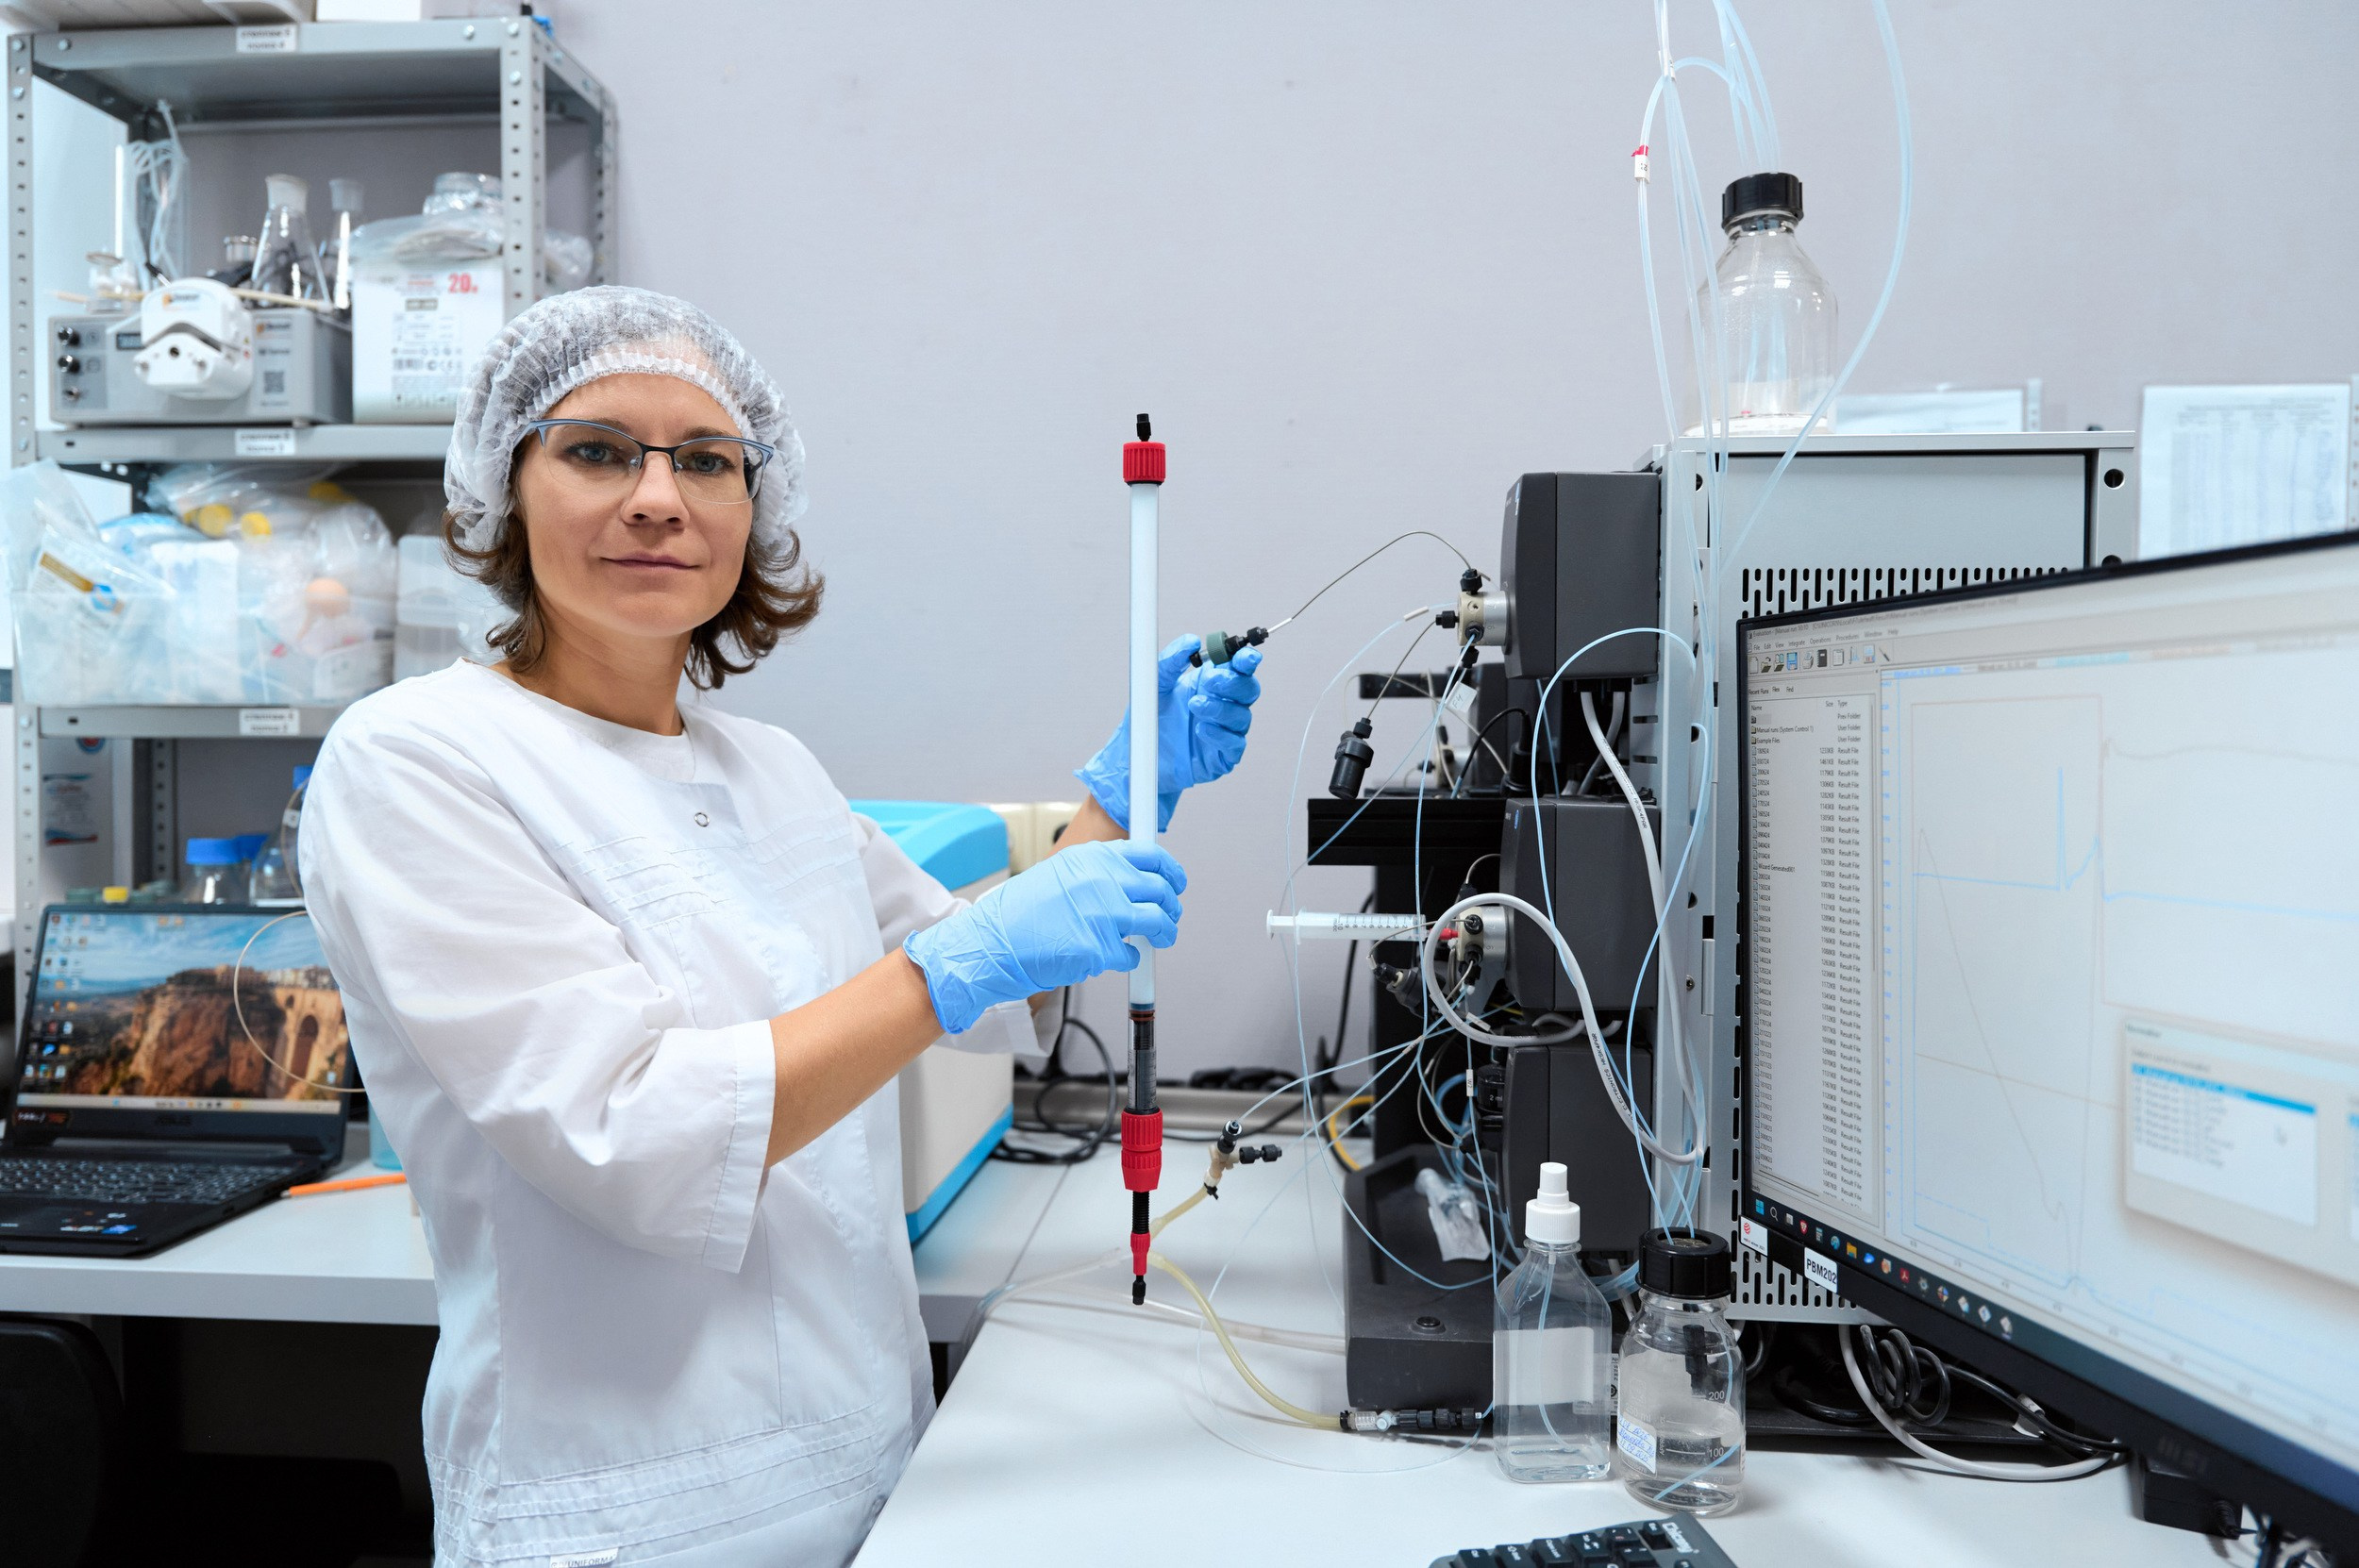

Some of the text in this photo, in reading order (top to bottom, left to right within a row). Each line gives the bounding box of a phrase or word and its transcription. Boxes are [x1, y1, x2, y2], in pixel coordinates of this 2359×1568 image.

[1806, 1259, 1837, 1284] PBM202
[1708, 1391, 1725, 1401] 200
[1709, 1447, 1724, 1458] 100
